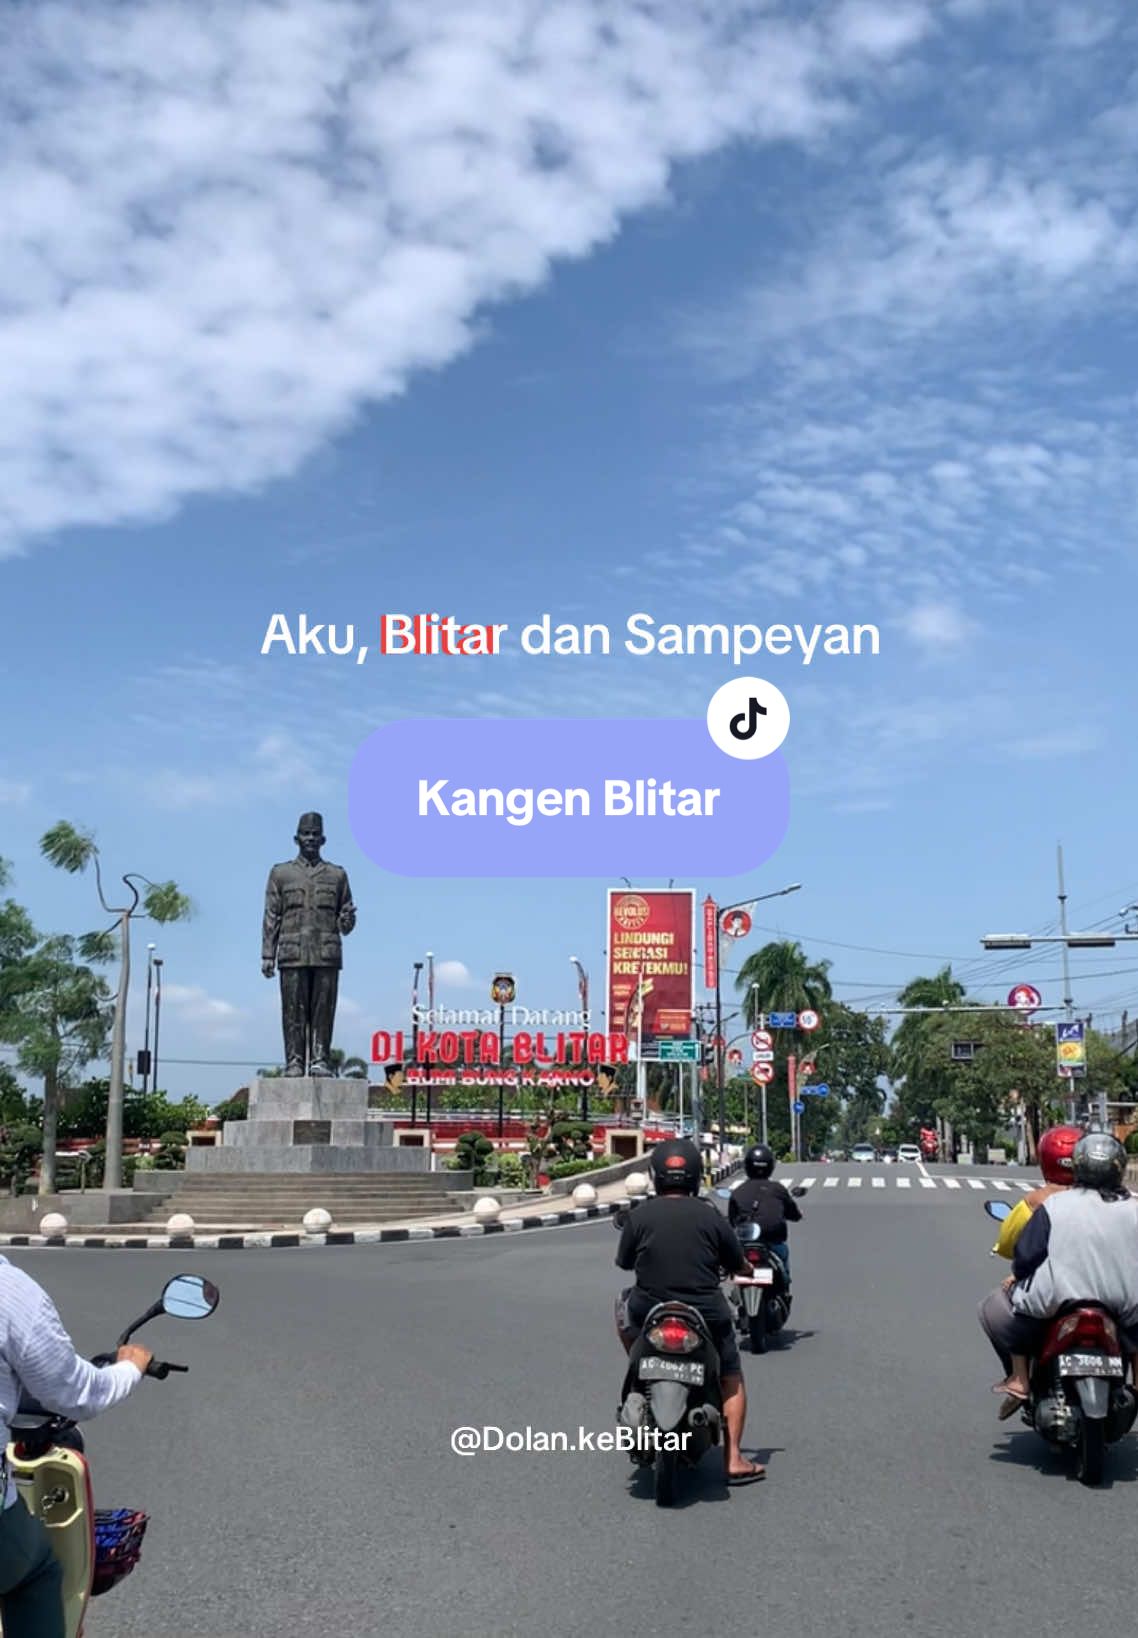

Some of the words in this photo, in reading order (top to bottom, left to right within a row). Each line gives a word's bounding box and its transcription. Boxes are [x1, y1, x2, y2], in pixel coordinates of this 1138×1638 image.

[614, 932, 674, 944] LINDUNGI
[411, 1003, 502, 1026] Selamat
[511, 1005, 592, 1029] Datang
[371, 1030, 404, 1064] DI
[416, 1031, 500, 1064] KOTA
[512, 1031, 630, 1065] BLITAR
[461, 1068, 518, 1087] BUNG
[521, 1069, 595, 1087] KARNO
